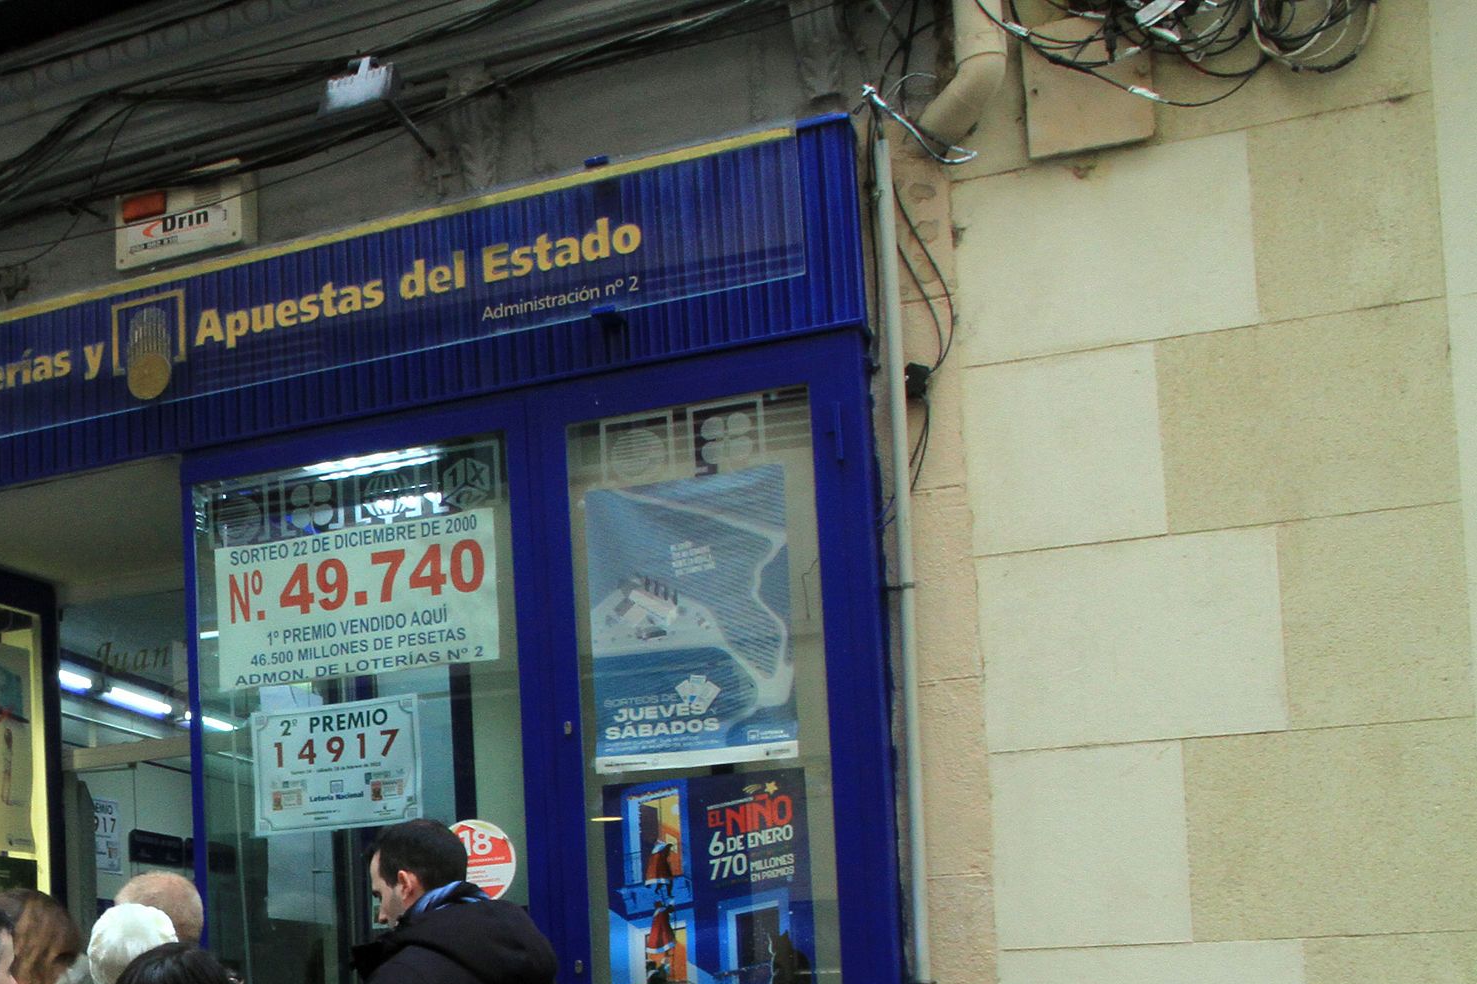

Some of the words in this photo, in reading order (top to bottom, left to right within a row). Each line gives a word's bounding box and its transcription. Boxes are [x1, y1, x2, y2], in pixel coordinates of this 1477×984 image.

[162, 210, 209, 233] Drin
[83, 342, 105, 381] y
[195, 278, 385, 349] Apuestas
[399, 251, 466, 300] del
[481, 216, 643, 284] Estado
[482, 285, 600, 321] Administración
[605, 278, 624, 297] nº
[628, 275, 640, 292] 2
[230, 543, 289, 566] SORTEO
[293, 541, 308, 557] 22
[312, 537, 331, 554] DE
[334, 522, 416, 549] DICIEMBRE
[421, 519, 441, 537] DE
[446, 514, 478, 533] 2000
[279, 538, 485, 615] 49.740
[267, 631, 280, 646] 1º
[283, 622, 337, 644] PREMIO
[340, 612, 407, 636] VENDIDO
[410, 603, 449, 627] AQUÍ
[235, 668, 310, 686] ADMON.
[315, 664, 339, 677] DE
[344, 651, 441, 672] LOTERÍAS
[447, 647, 469, 662] Nº
[475, 645, 485, 657] 2
[250, 650, 294, 667] 46.500
[298, 640, 369, 662] MILLONES
[373, 635, 393, 651] DE
[398, 627, 467, 648] PESETAS
[280, 718, 298, 737] 2º
[309, 708, 389, 734] PREMIO
[605, 717, 721, 740] SÁBADOS
[613, 703, 706, 722] JUEVES
[707, 810, 724, 828] EL
[725, 793, 793, 836] NIÑO
[708, 831, 725, 856] 6
[726, 834, 745, 853] DE
[747, 824, 794, 848] ENERO
[709, 853, 748, 881] 770
[750, 853, 794, 872] MILLONES
[762, 866, 795, 880] PREMIOS
